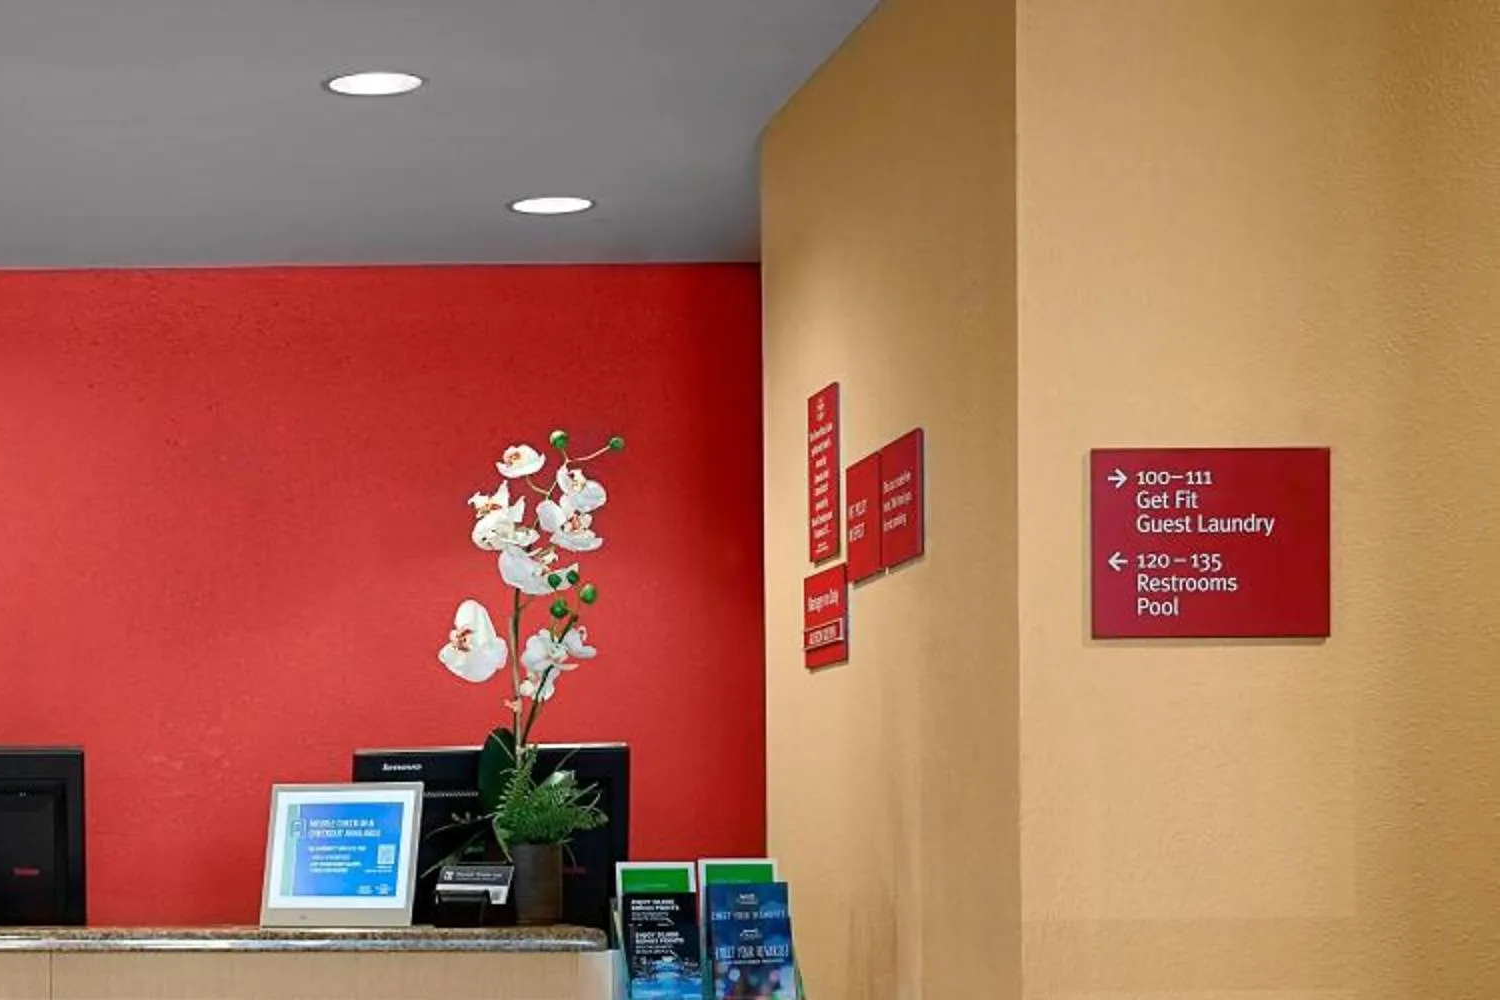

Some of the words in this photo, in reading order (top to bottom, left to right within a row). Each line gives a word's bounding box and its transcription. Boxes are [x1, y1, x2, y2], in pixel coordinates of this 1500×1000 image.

[1136, 491, 1169, 509] Get
[1175, 490, 1199, 509] Fit
[1136, 514, 1192, 533] Guest
[1197, 513, 1275, 536] Laundry
[1136, 573, 1238, 593] Restrooms
[1136, 597, 1179, 616] Pool
